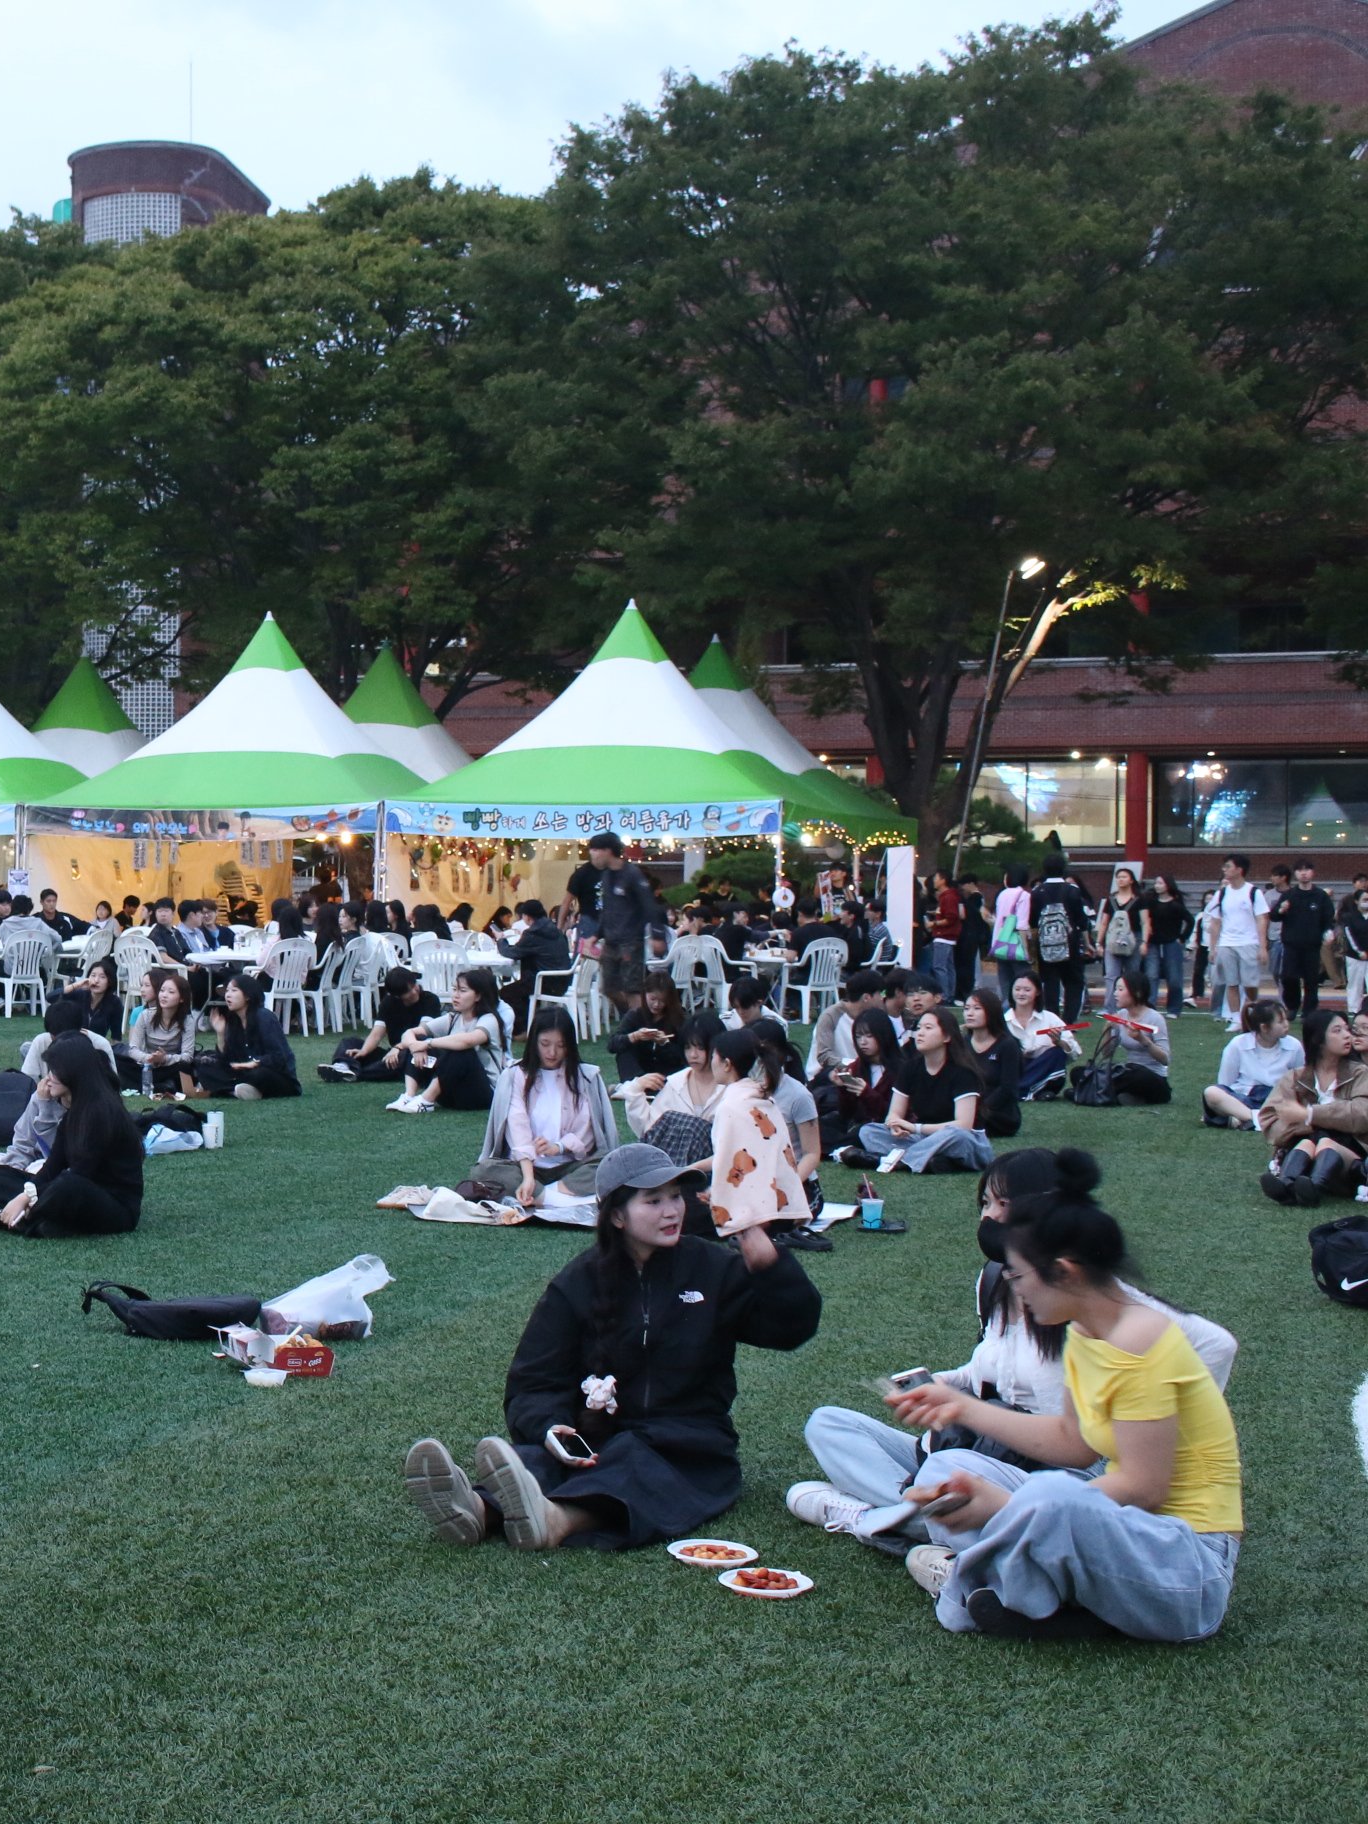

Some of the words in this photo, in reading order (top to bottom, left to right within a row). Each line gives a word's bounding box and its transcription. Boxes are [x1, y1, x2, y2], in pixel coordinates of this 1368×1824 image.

[461, 807, 526, 832] 빵빵하게
[532, 810, 568, 832] 쏘는
[576, 810, 612, 832] 방과
[620, 809, 692, 833] 여름휴가
